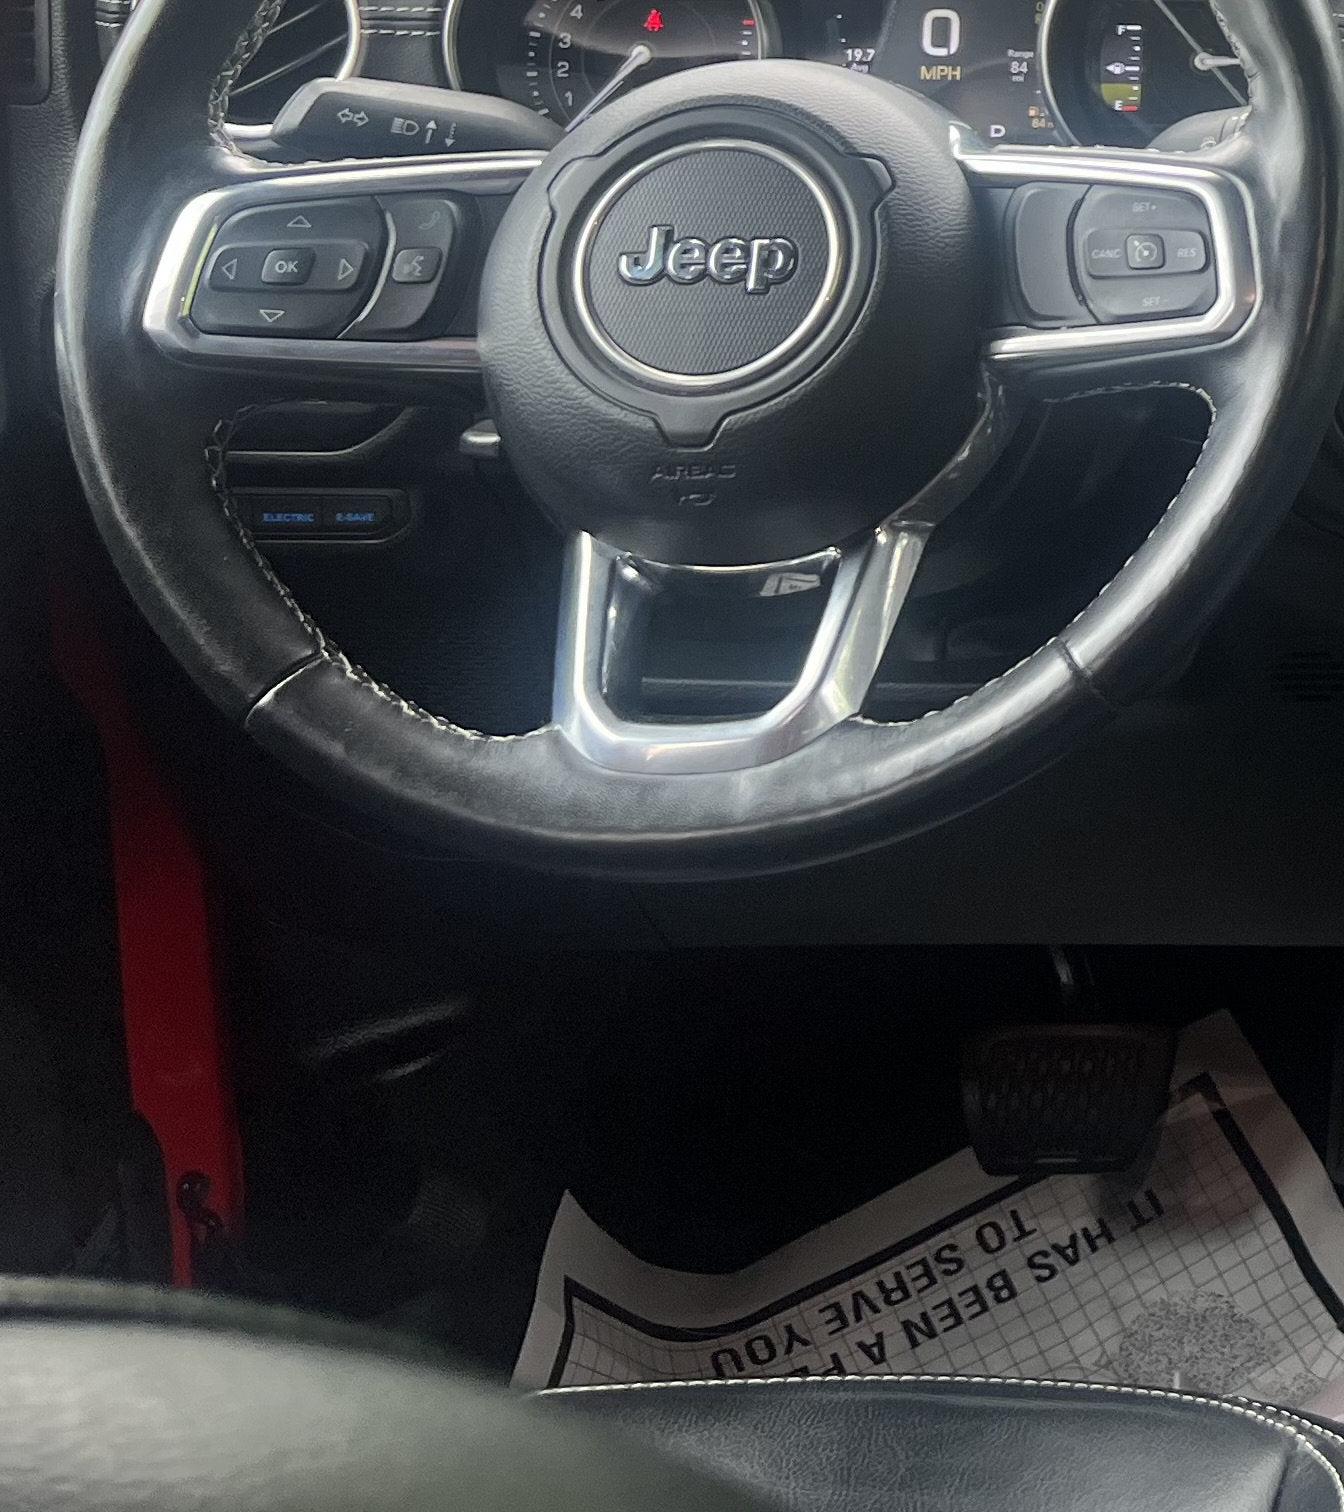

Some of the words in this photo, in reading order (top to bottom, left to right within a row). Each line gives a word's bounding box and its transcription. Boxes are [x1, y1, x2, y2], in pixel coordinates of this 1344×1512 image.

[570, 4, 583, 20] 4
[922, 8, 961, 57] 0
[1117, 25, 1126, 35] F
[558, 33, 571, 49] 3
[846, 49, 875, 62] 19.7
[557, 62, 569, 78] 2
[920, 65, 961, 81] MPH
[1010, 61, 1028, 74] 84
[564, 91, 573, 107] 1
[1114, 100, 1123, 111] E
[990, 125, 1006, 137] D
[274, 259, 299, 274] OK
[618, 224, 799, 294] Jeep
[1123, 1189, 1165, 1233] IT
[976, 1209, 1038, 1254] TO
[1026, 1218, 1117, 1283] HAS
[816, 1242, 966, 1336] SERVE
[899, 1268, 1018, 1350] BEEN
[708, 1323, 813, 1379] YOU
[855, 1331, 886, 1366] A
